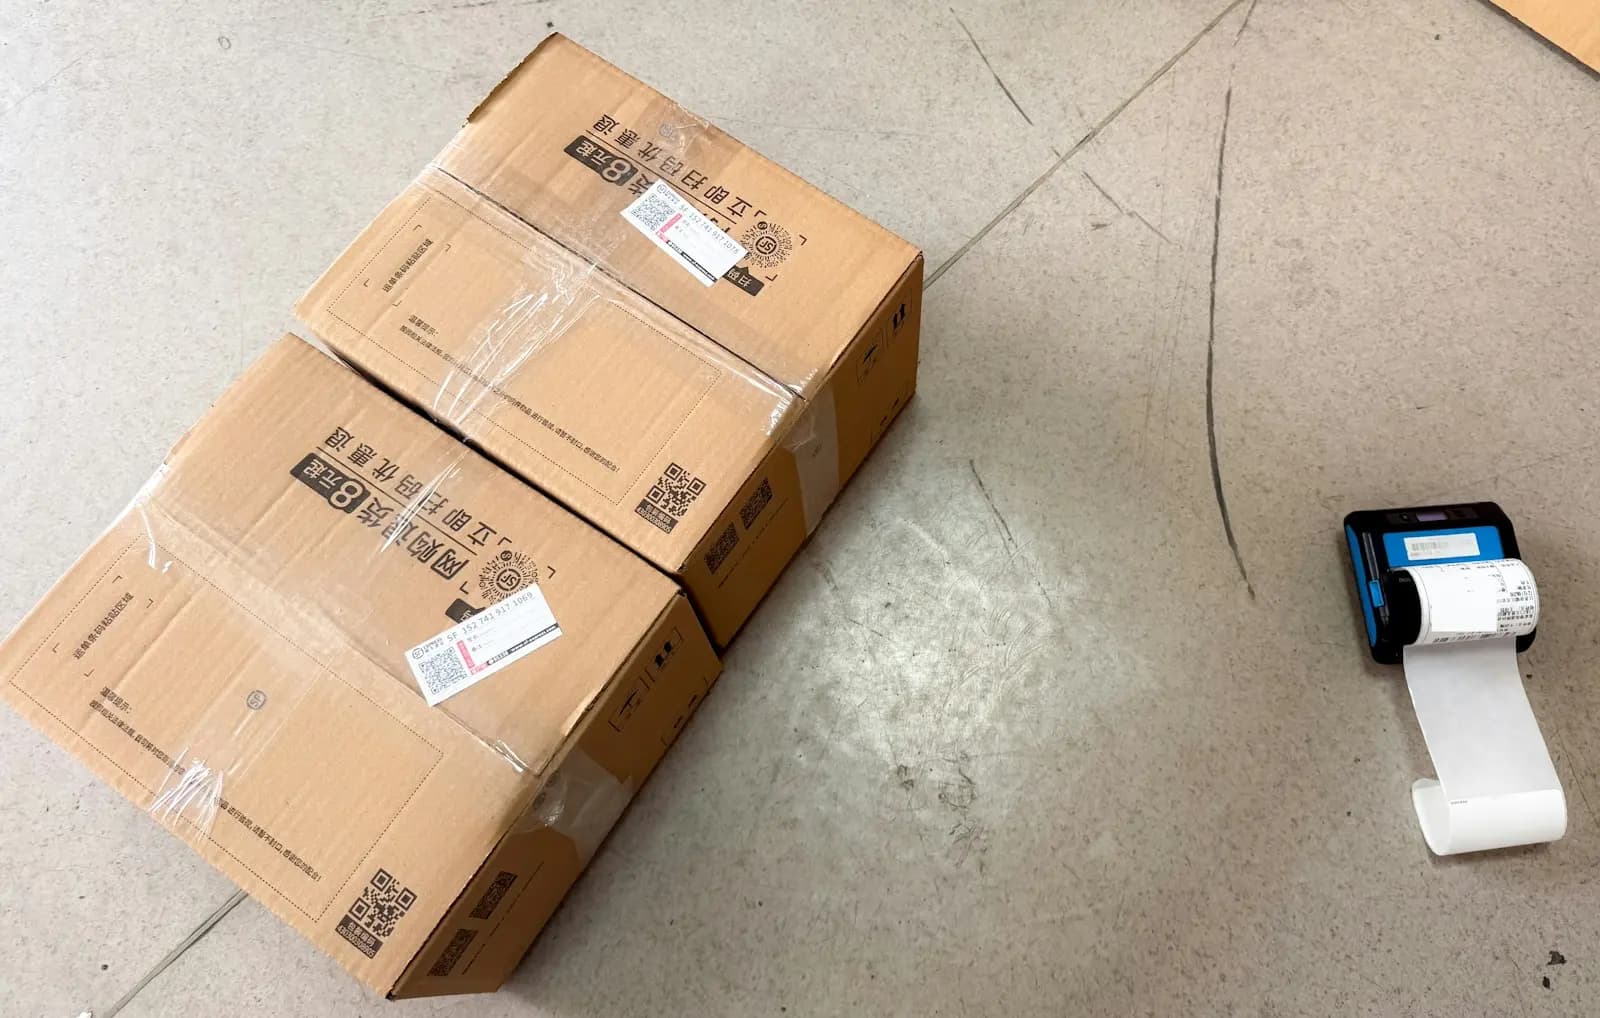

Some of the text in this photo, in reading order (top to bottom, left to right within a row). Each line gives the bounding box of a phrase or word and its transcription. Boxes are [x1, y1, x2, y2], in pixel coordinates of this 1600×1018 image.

[593, 112, 752, 217] 立即扫码优惠退
[324, 425, 496, 547] 立即扫码优惠退
[446, 630, 459, 642] SF
[462, 621, 477, 633] 152
[478, 612, 494, 625] 741
[495, 603, 511, 616] 917
[512, 591, 533, 606] 1069
